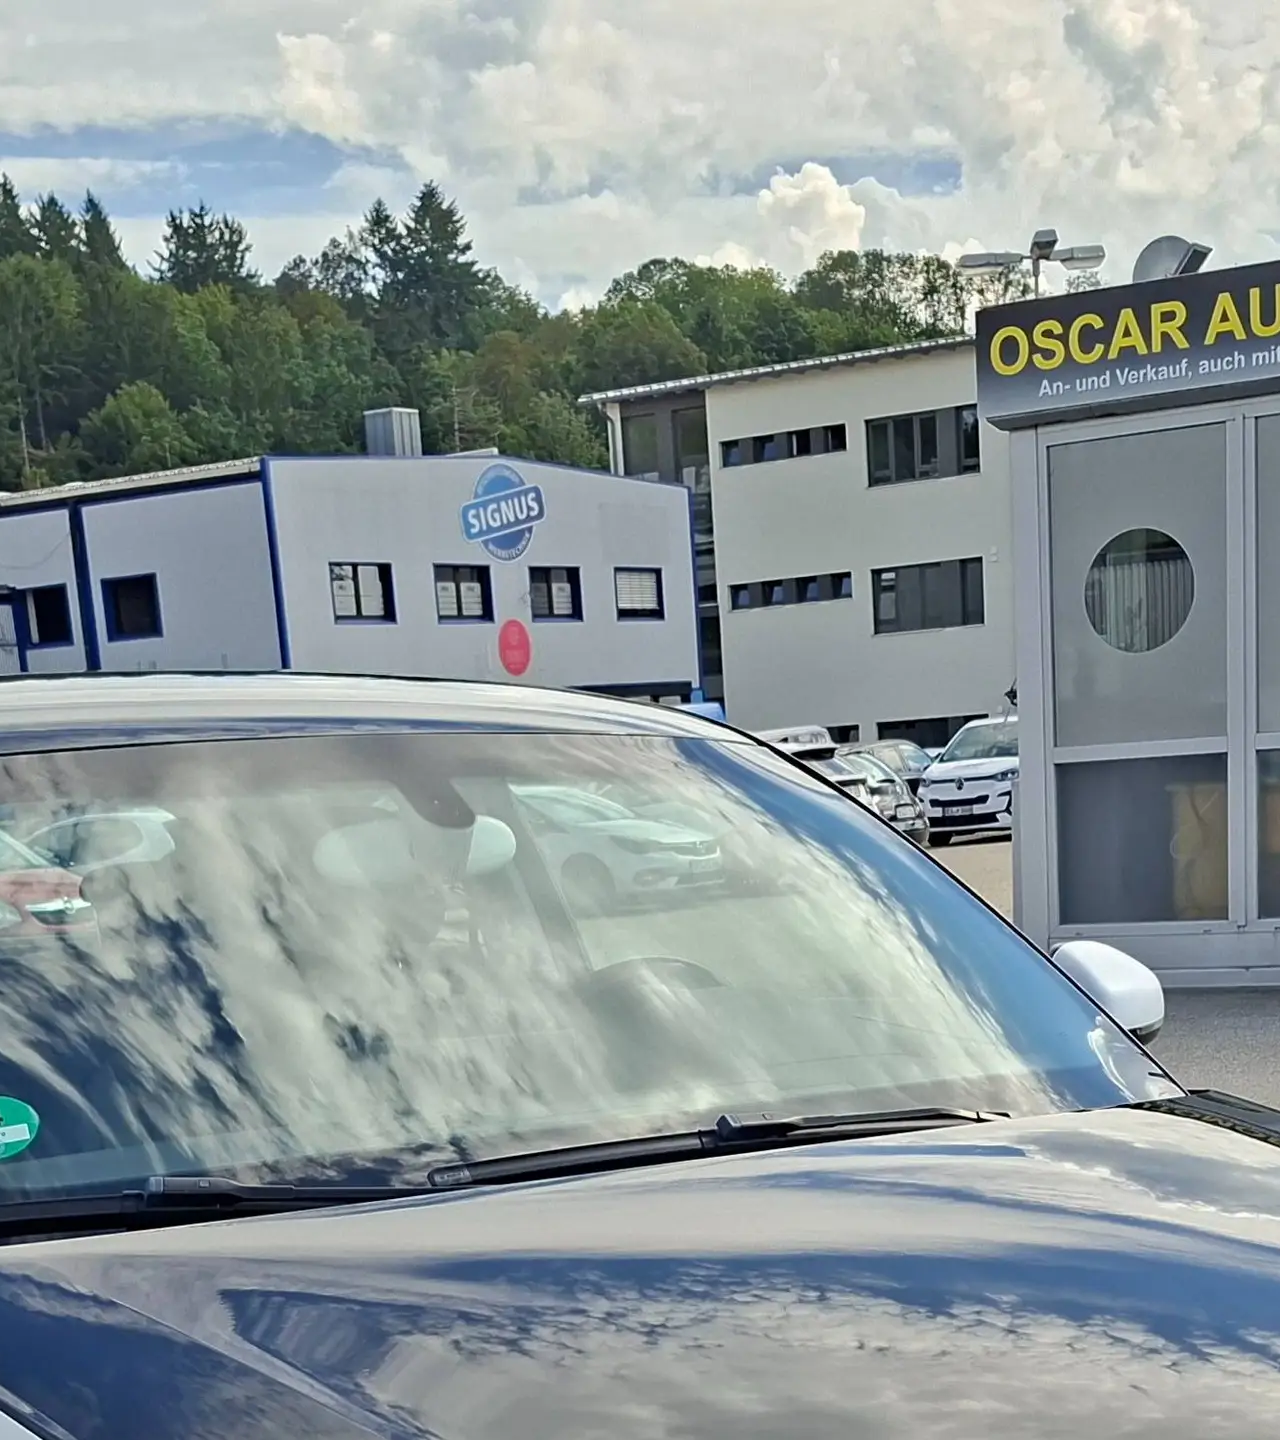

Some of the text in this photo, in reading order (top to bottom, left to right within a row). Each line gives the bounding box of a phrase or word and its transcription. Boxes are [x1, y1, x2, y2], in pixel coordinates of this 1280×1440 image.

[989, 299, 1190, 377] OSCAR
[1038, 378, 1071, 398] An-
[1076, 370, 1111, 393] und
[1115, 357, 1193, 387] Verkauf,
[1198, 350, 1246, 375] auch
[467, 492, 540, 535] SIGNUS
